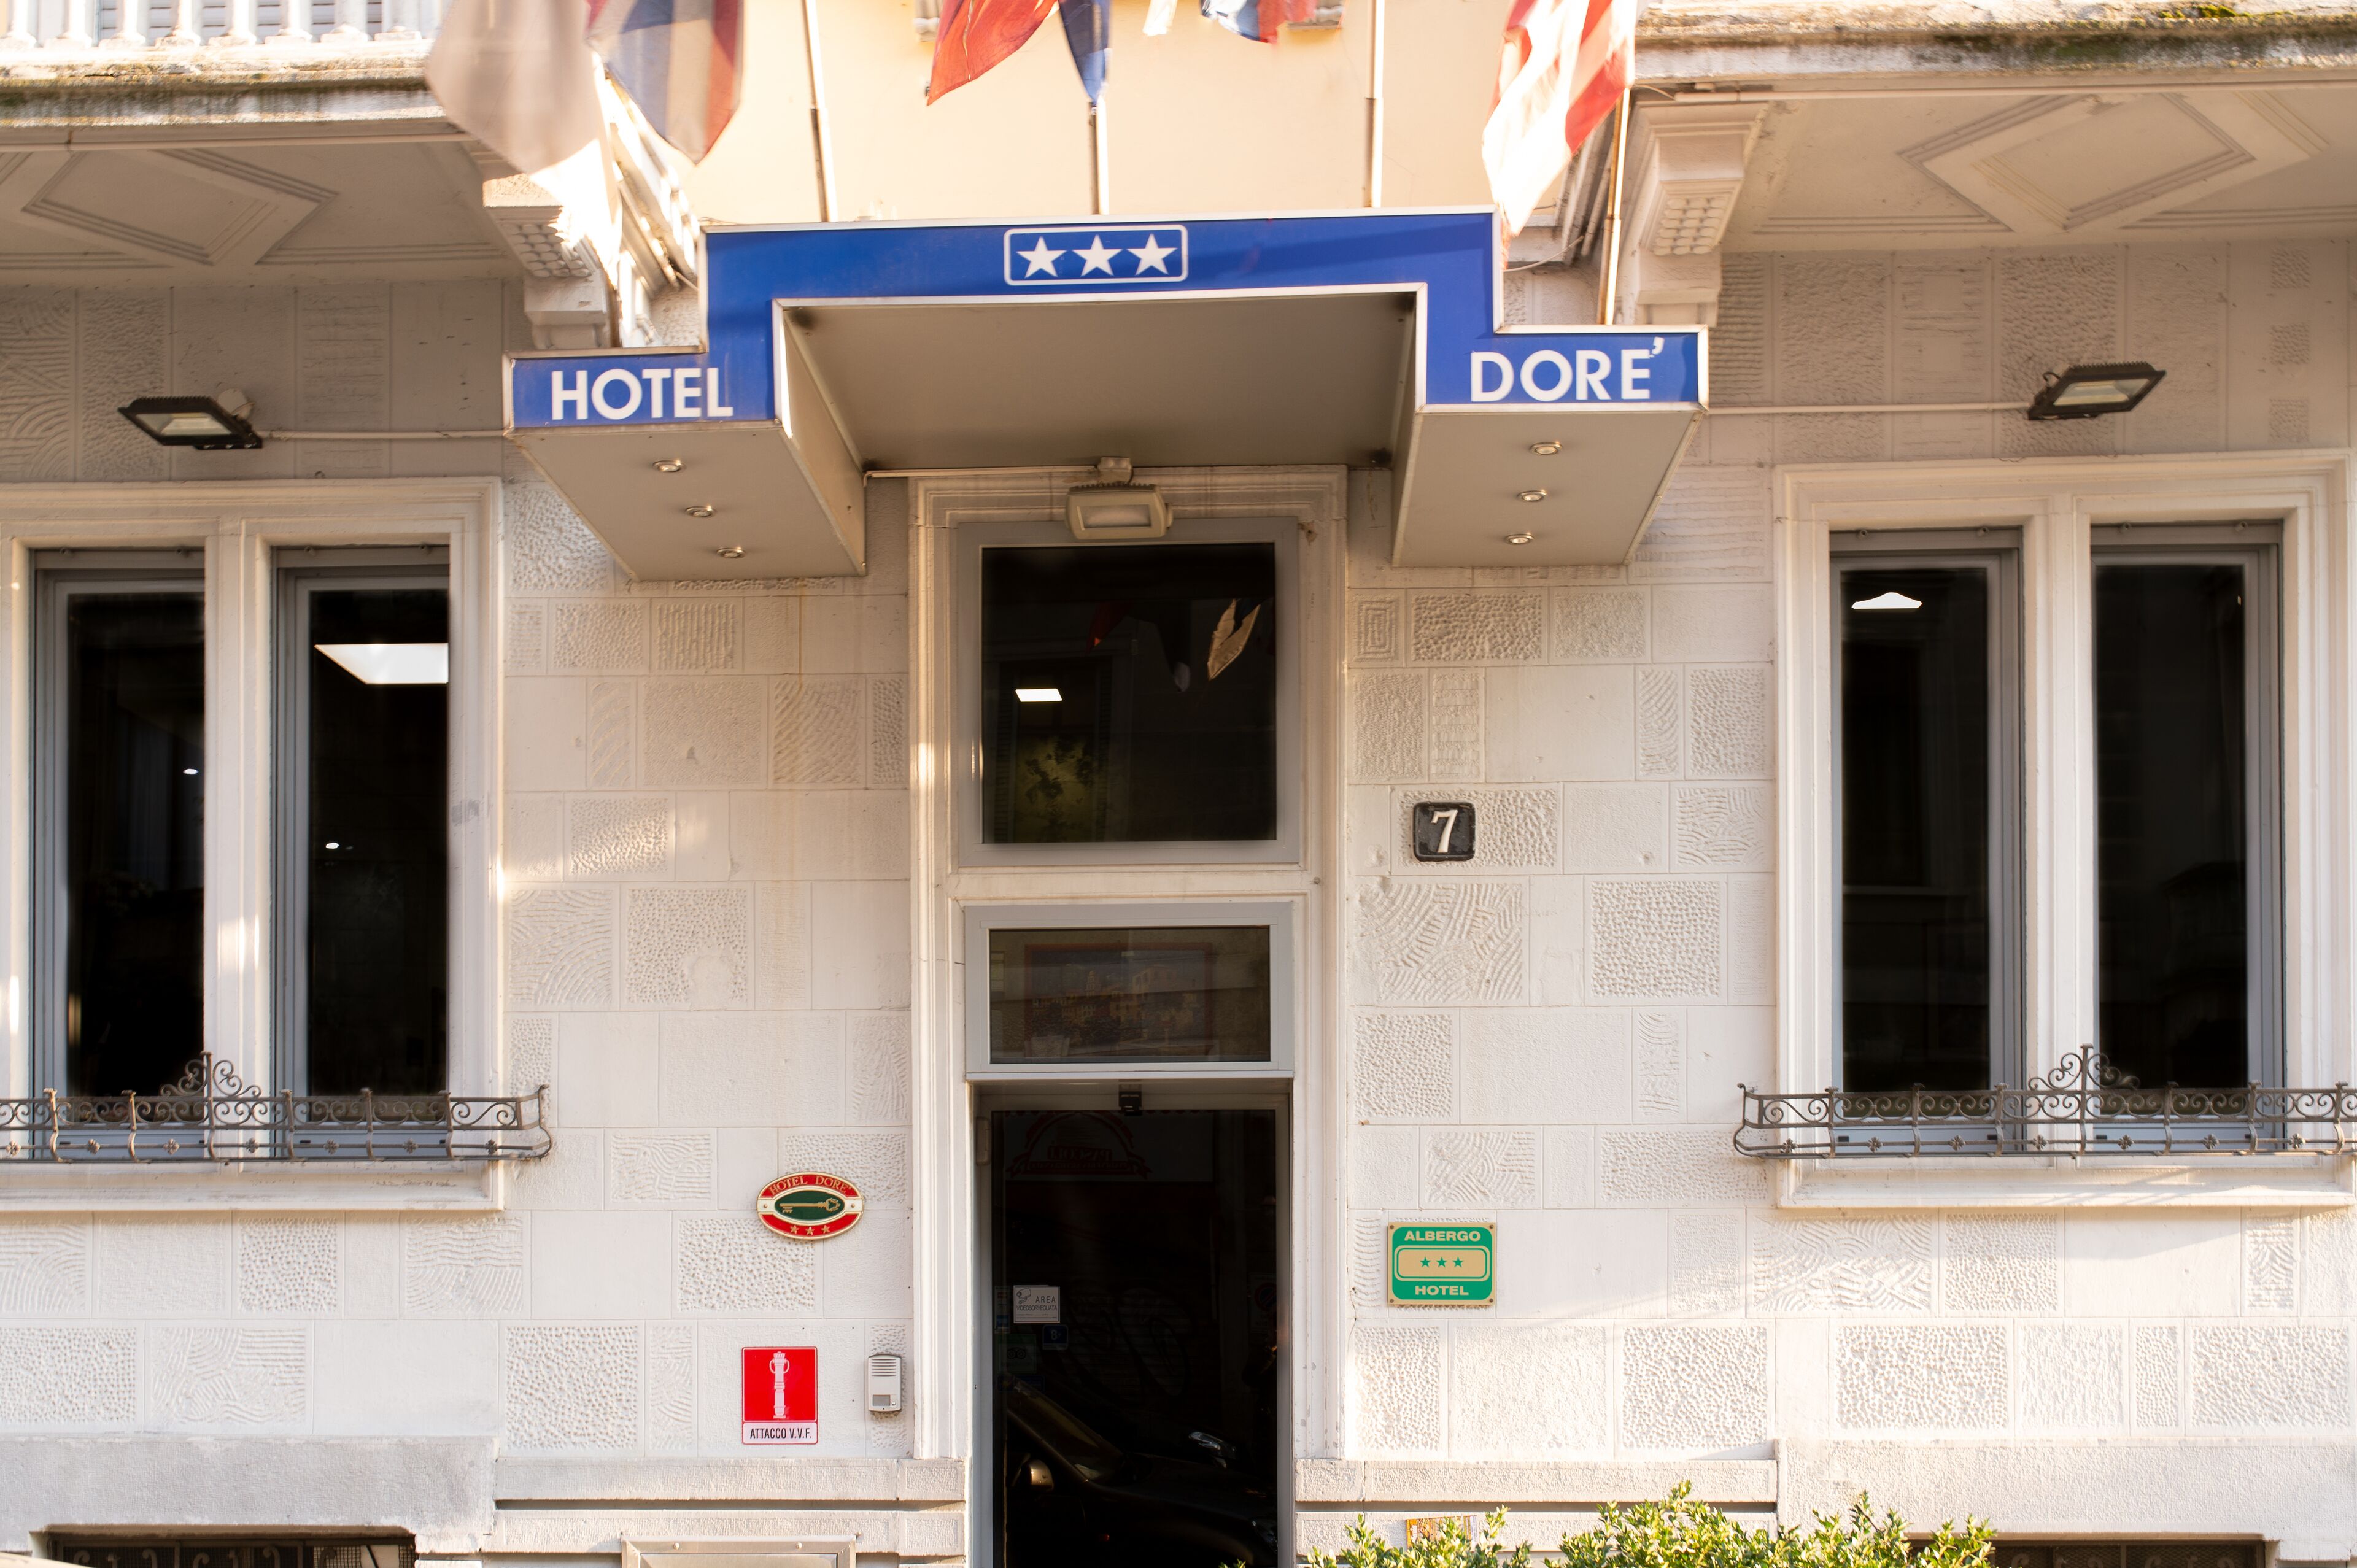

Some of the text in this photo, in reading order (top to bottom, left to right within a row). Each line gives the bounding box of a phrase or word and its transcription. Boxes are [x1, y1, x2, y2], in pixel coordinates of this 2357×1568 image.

[552, 368, 733, 420] HOTEL
[1430, 809, 1458, 853] 7
[769, 1176, 808, 1195] HOTEL
[1404, 1230, 1481, 1242] ALBERGO
[1415, 1285, 1469, 1296] HOTEL
[750, 1427, 811, 1439] ATTACCO V.V.F.
